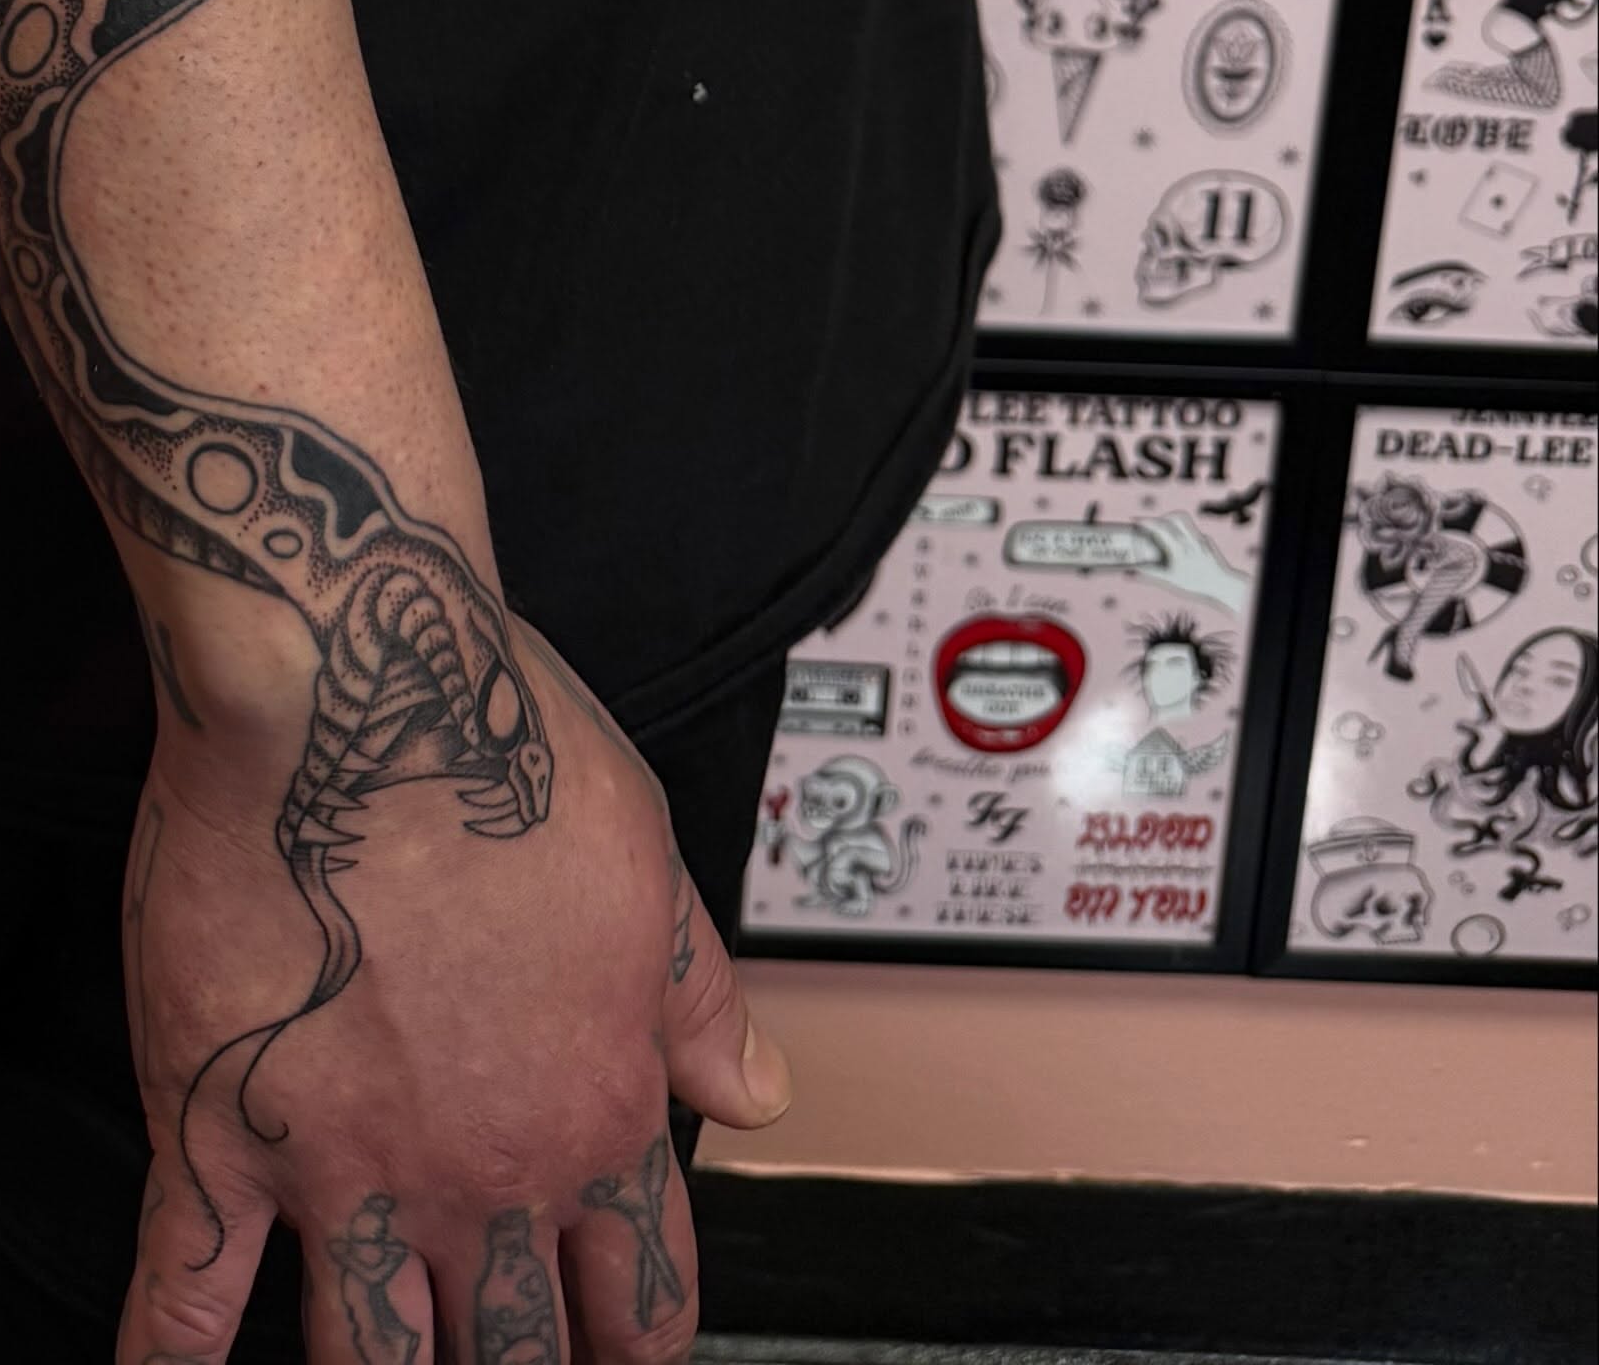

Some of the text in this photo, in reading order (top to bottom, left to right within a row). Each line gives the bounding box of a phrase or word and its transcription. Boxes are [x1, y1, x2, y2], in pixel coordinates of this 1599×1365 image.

[1058, 395, 1243, 428] TATTOO
[995, 431, 1230, 481] FLASH
[1375, 428, 1594, 467] DEAD-LEE
